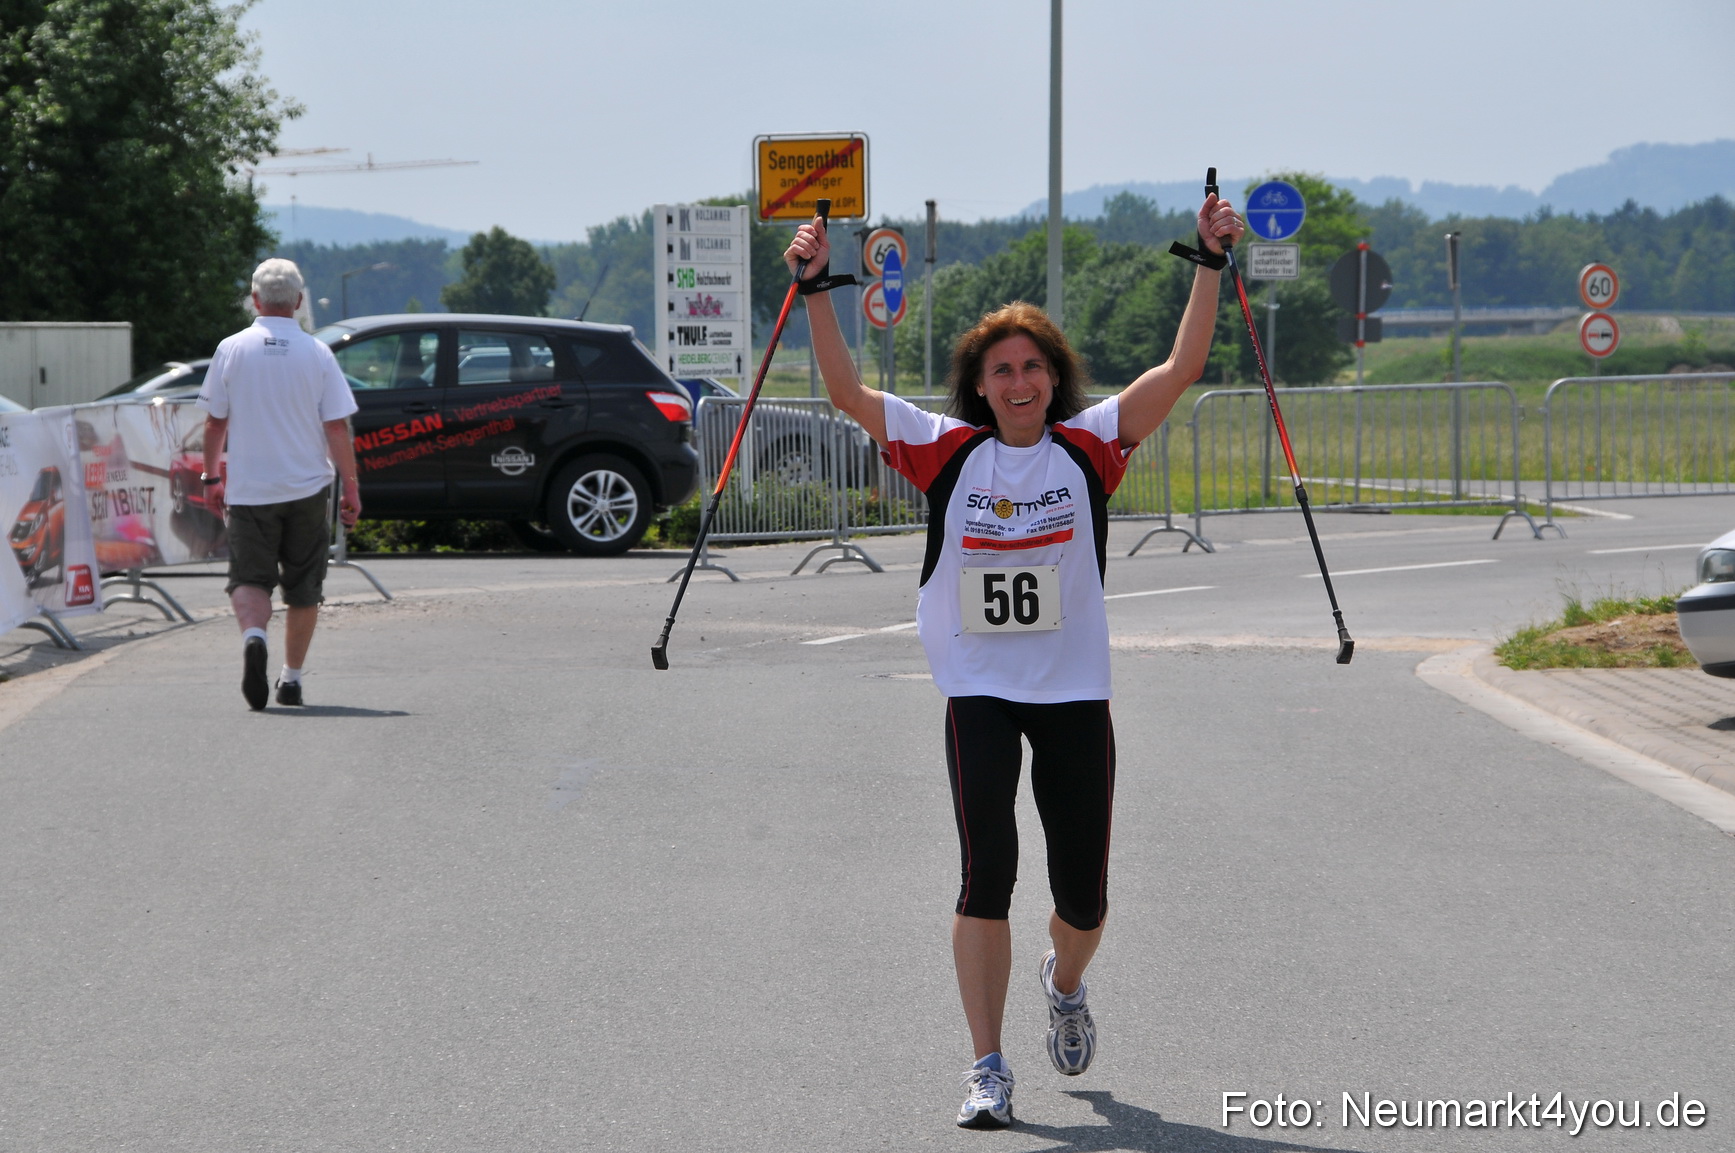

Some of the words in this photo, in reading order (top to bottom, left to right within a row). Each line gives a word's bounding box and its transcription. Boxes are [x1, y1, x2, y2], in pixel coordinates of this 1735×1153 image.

[768, 149, 855, 174] Sengenthal
[780, 177, 798, 188] am
[805, 176, 843, 190] Anger
[677, 268, 695, 289] SHB
[1589, 277, 1611, 297] 60
[677, 326, 707, 346] THULE
[354, 412, 444, 453] NISSAN
[453, 383, 563, 423] Vertriebspartner
[363, 414, 516, 472] Neumarkt-Sengenthal
[496, 455, 530, 464] NISSAN
[967, 487, 1072, 519] SCHOTTNER
[997, 524, 1007, 532] Str.
[983, 572, 1040, 626] 56
